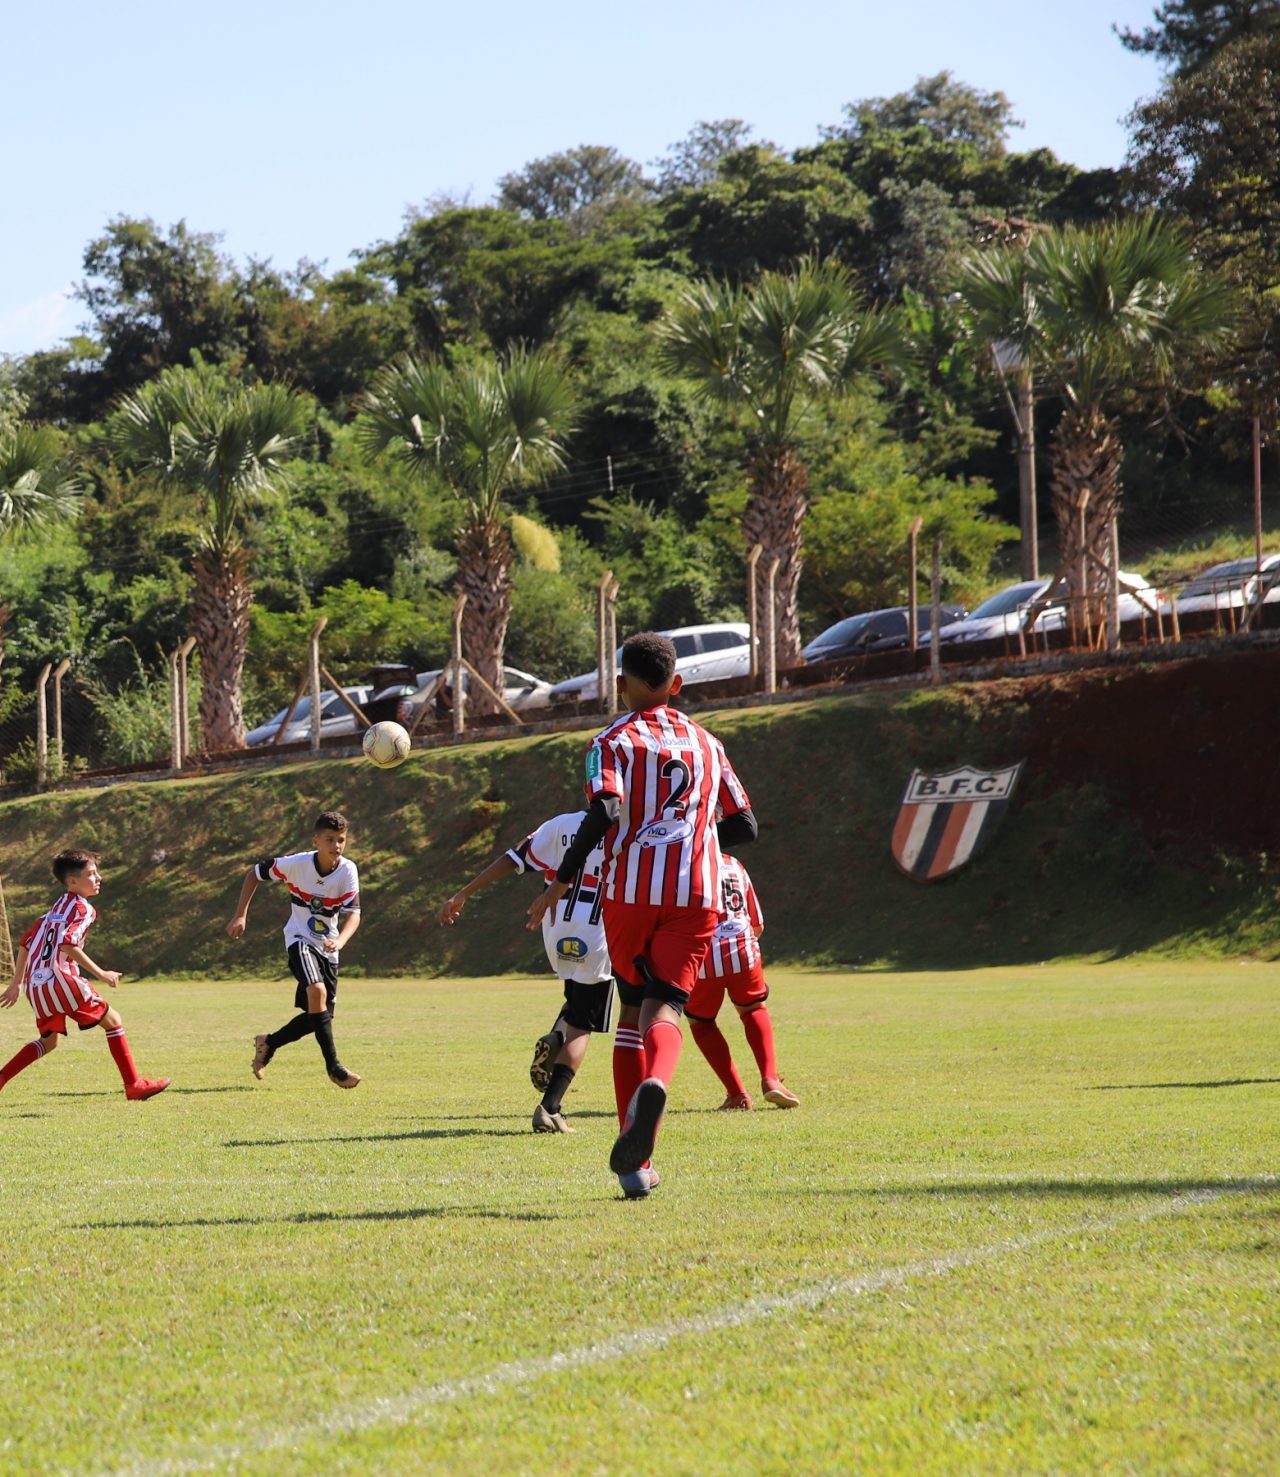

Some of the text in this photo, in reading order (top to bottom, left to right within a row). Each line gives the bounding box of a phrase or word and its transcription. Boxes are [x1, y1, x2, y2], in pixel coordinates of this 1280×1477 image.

[662, 760, 688, 810] 2
[916, 778, 1004, 796] B.F.C.
[42, 928, 55, 960] 8
